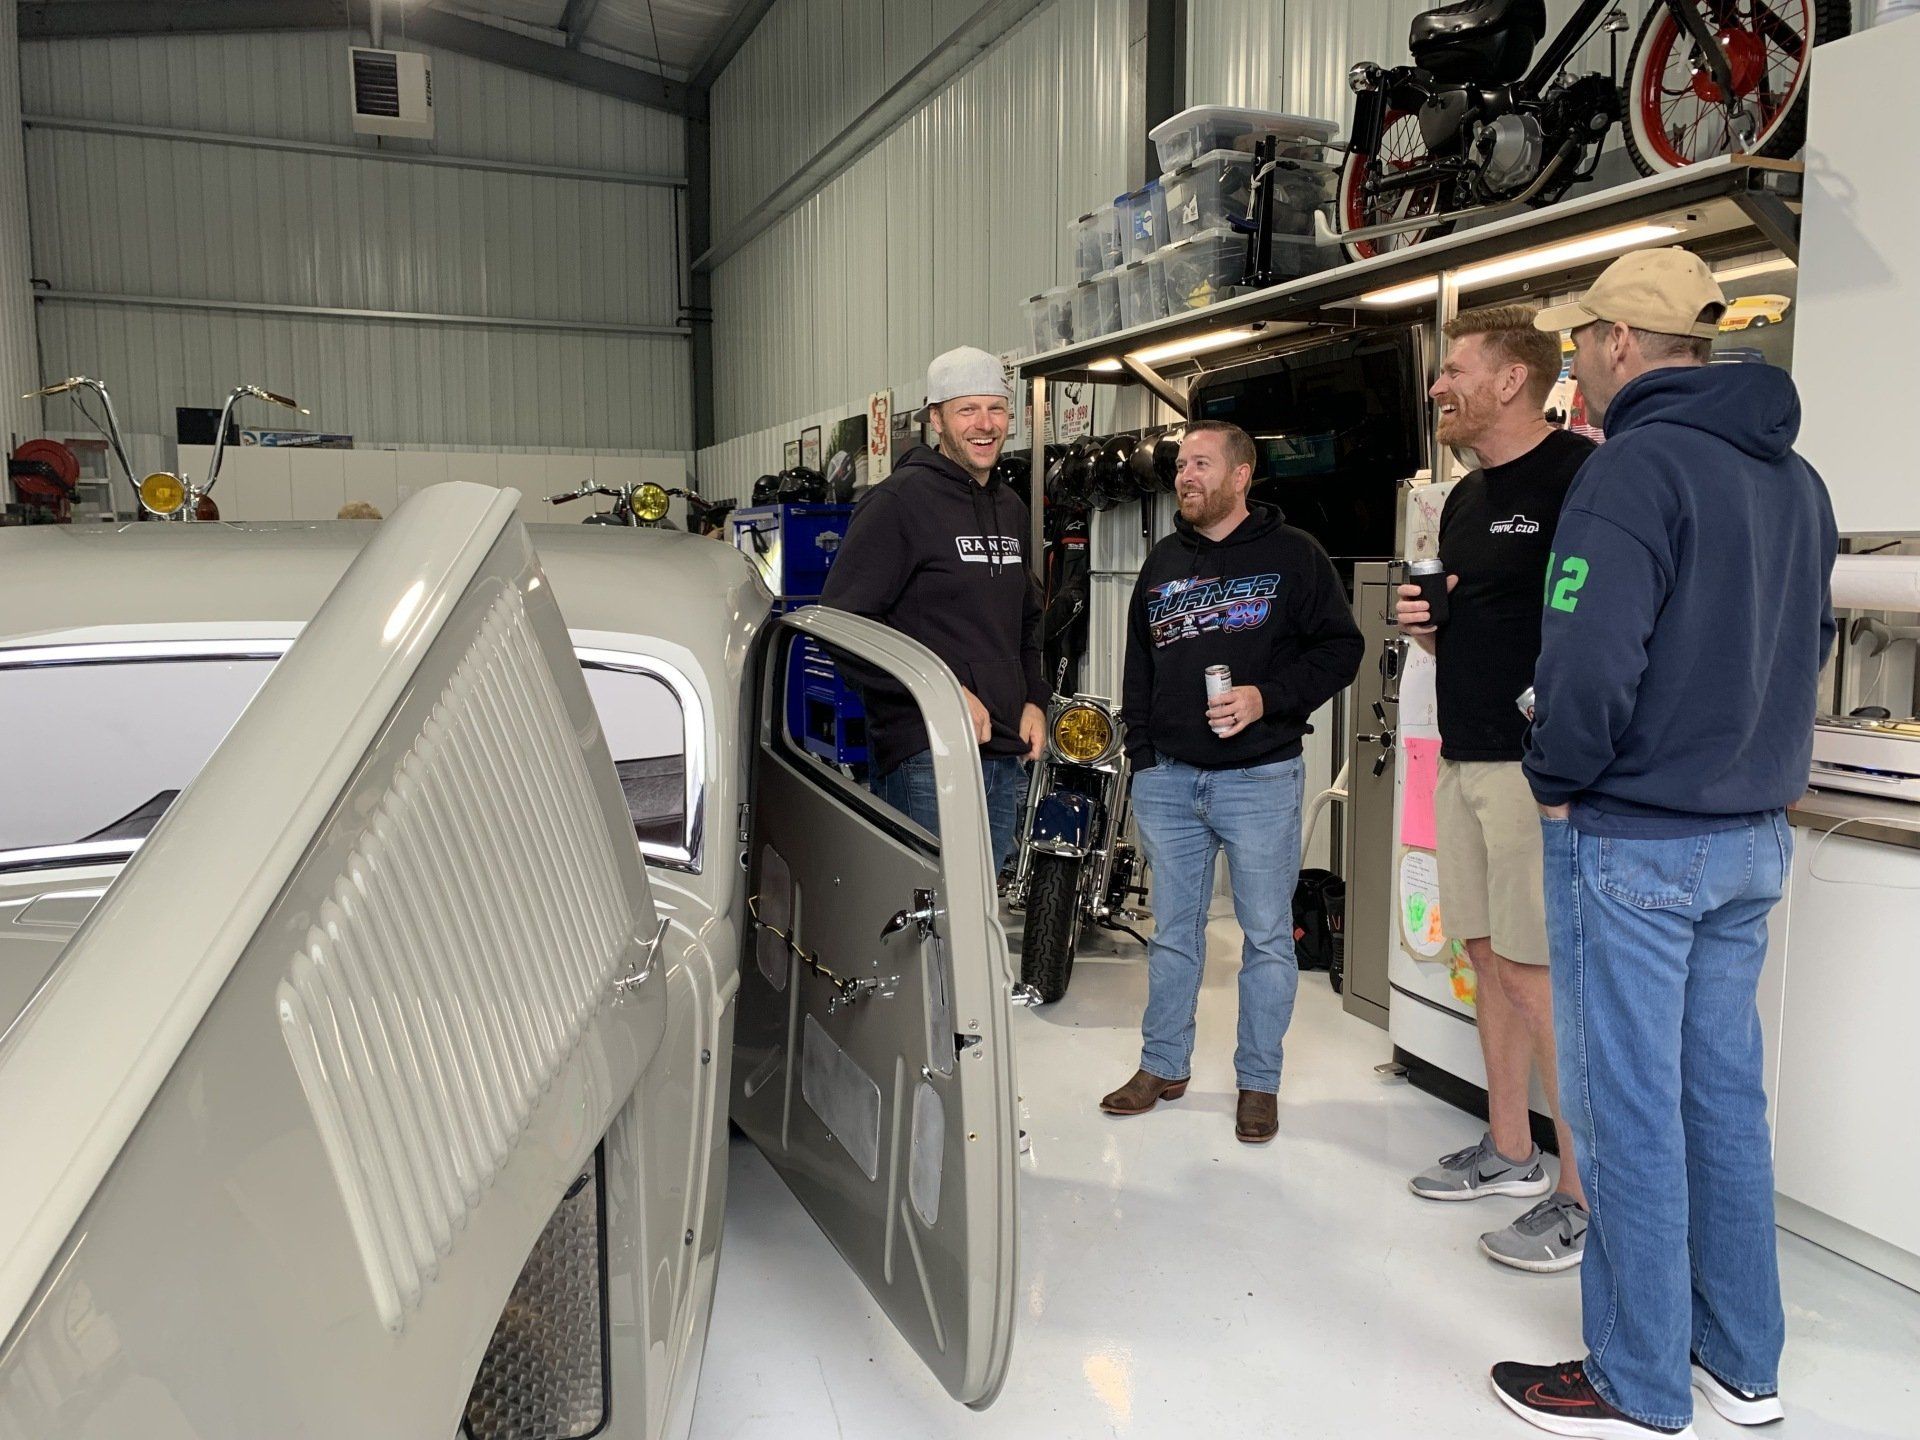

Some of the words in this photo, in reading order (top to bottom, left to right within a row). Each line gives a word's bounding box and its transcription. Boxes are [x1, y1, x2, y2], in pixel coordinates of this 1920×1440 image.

[1492, 523, 1536, 534] PNW_C10
[960, 539, 998, 553] RAN
[1148, 573, 1281, 623] TURNER
[1222, 597, 1272, 634] 29
